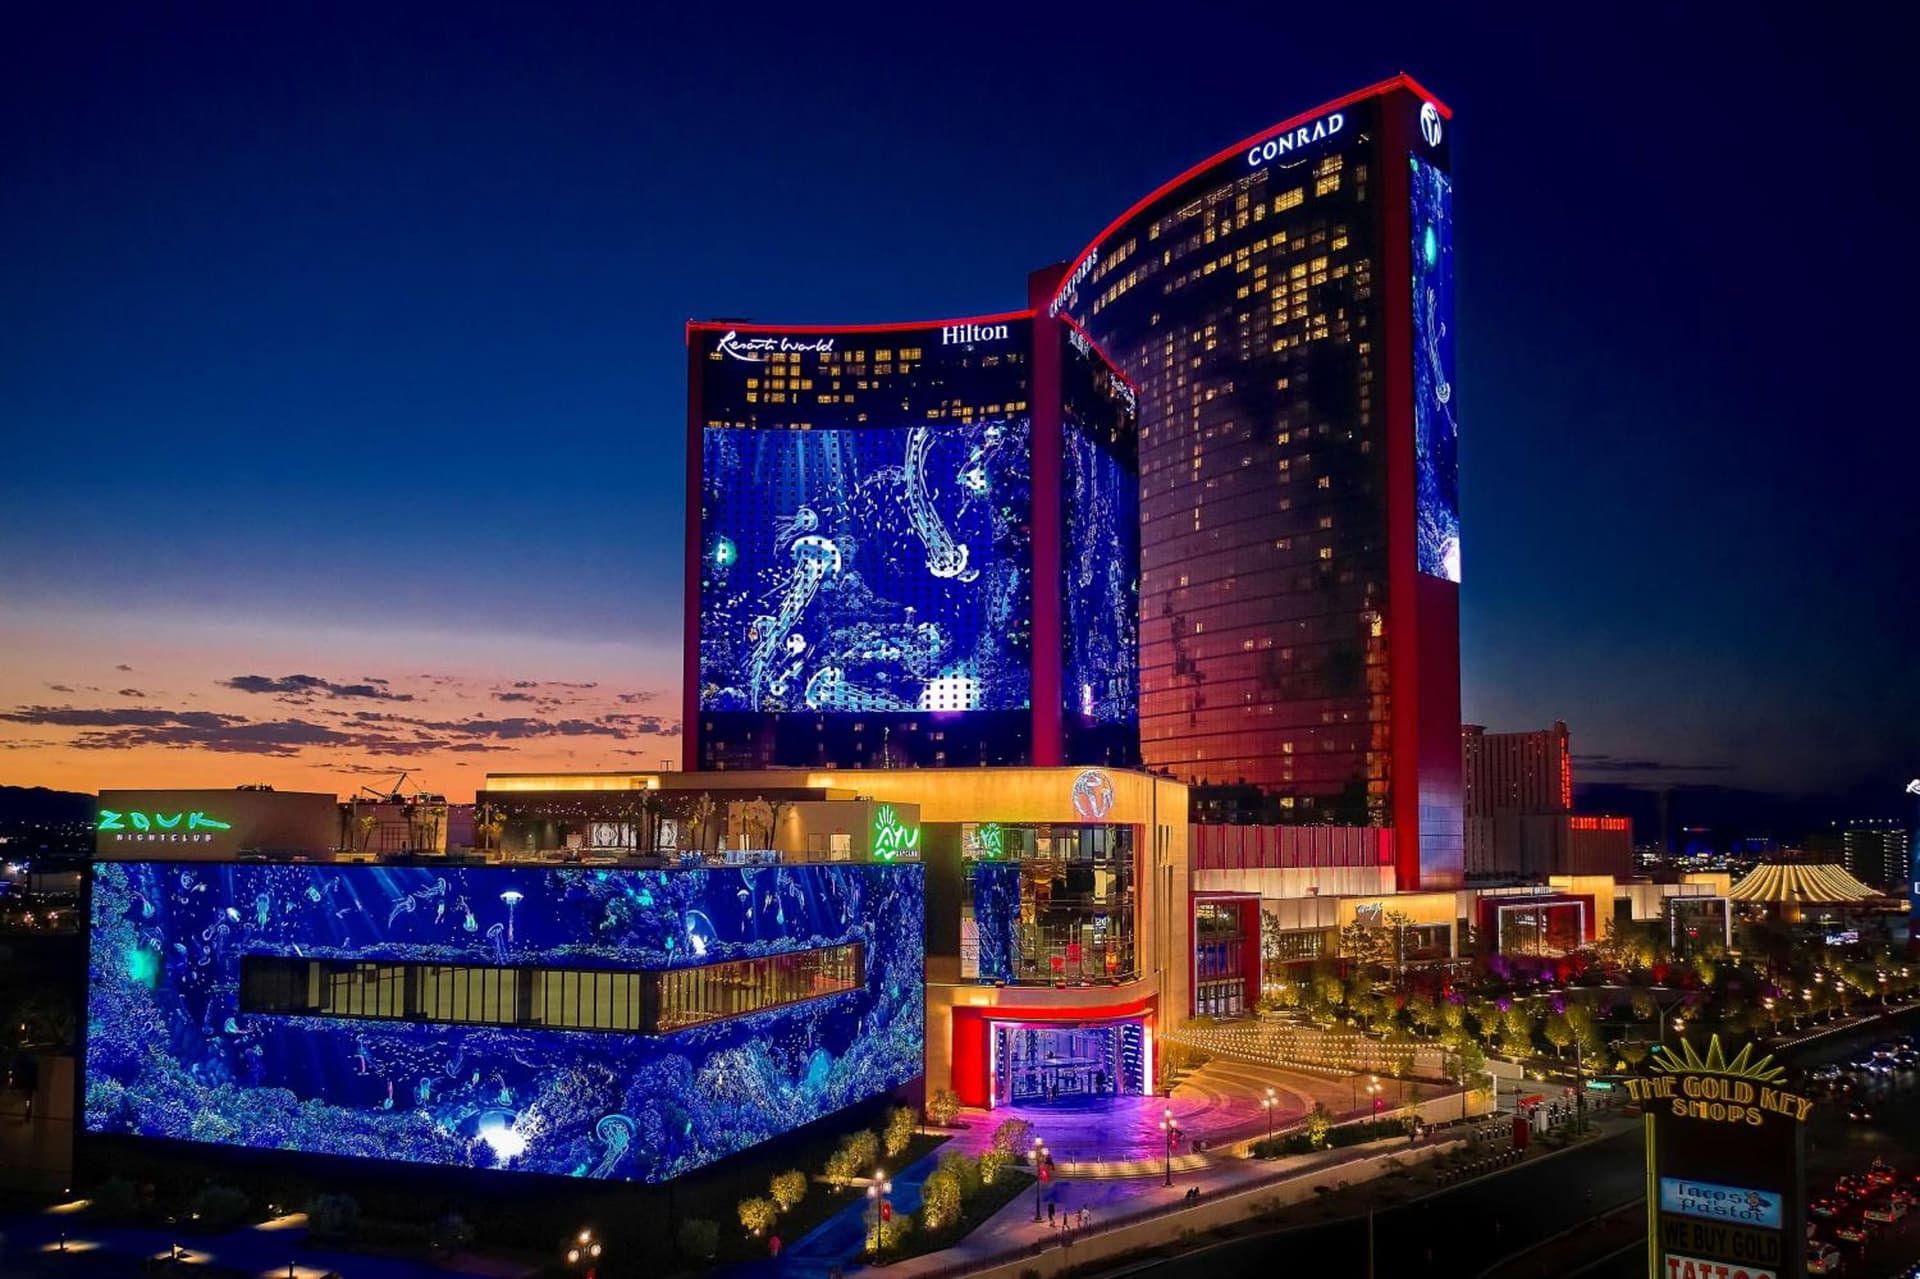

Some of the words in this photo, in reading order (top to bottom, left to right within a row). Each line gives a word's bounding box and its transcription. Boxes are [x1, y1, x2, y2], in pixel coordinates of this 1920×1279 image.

[1247, 113, 1344, 167] CONRAD
[716, 330, 778, 361] Resorts
[780, 337, 834, 351] World
[942, 323, 1009, 345] Hilton
[98, 809, 231, 830] ZOUK
[116, 833, 212, 842] NIGHTCLUB
[1624, 1076, 1677, 1100] THE
[1682, 1075, 1753, 1104] GOLD
[1760, 1087, 1813, 1121] KEY
[1671, 1098, 1763, 1126] SHOPS
[1678, 1180, 1742, 1202] Tacos
[1679, 1197, 1765, 1222] Pastor
[1664, 1222, 1689, 1249] WE
[1694, 1224, 1727, 1253] BUY
[1732, 1230, 1778, 1261] GOLD
[1667, 1257, 1771, 1279] TATT
